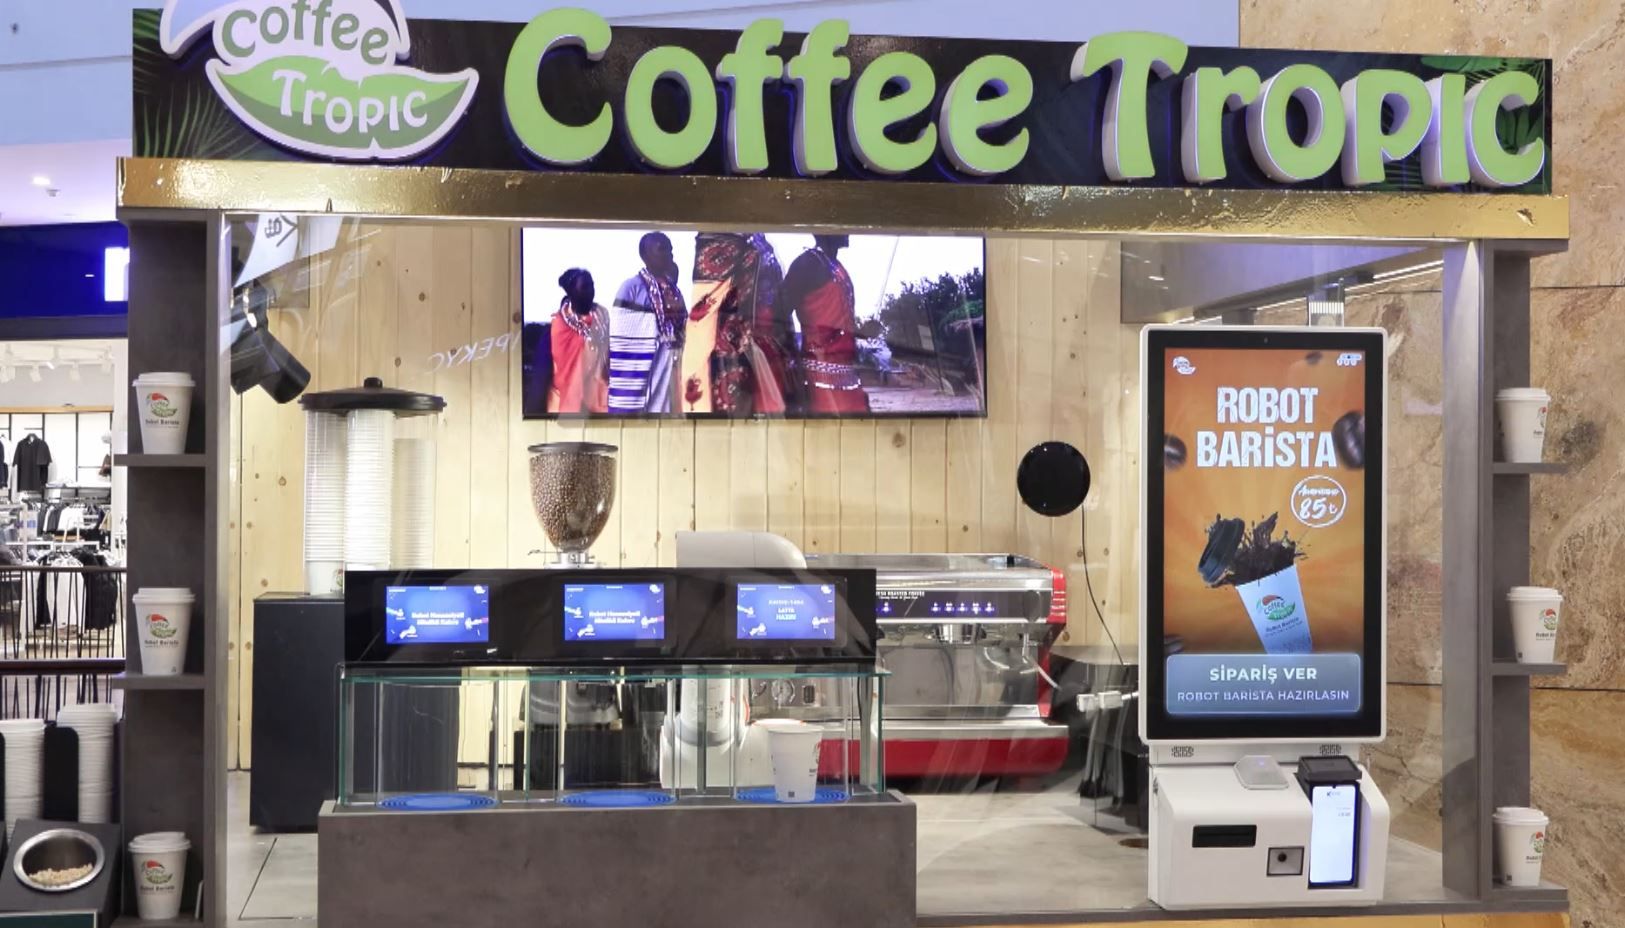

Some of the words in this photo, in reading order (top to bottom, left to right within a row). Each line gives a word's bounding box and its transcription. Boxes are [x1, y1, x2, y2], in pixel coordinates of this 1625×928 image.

[504, 8, 1035, 178] Coffee
[1070, 30, 1547, 190] Tropic
[1216, 387, 1319, 424] ROBOT
[1209, 664, 1278, 685] SİPARİŞ
[1283, 667, 1318, 681] VER
[1177, 691, 1220, 702] ROBOT
[1278, 690, 1350, 702] HAZIRLASIN
